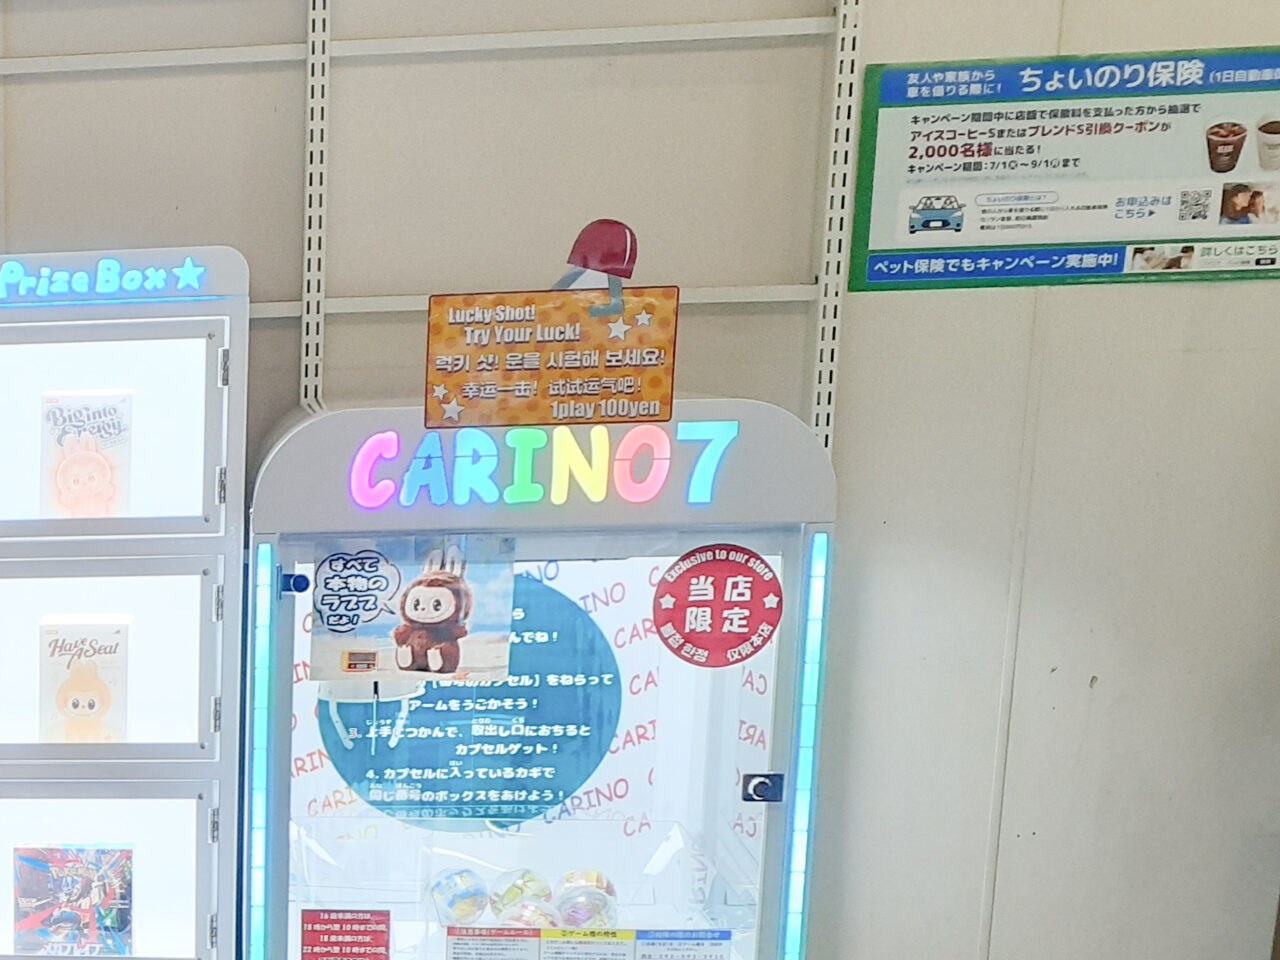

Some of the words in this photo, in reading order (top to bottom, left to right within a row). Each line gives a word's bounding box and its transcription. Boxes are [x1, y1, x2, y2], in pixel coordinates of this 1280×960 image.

[1019, 58, 1205, 93] ちょいのり保険
[95, 257, 167, 294] Box
[873, 252, 1118, 275] ペット保険でもキャンペーン実施中!
[448, 306, 492, 325] Lucky
[495, 304, 536, 322] Shot!
[464, 326, 491, 346] Try
[494, 325, 533, 343] Your
[536, 322, 581, 341] Luck!
[435, 354, 471, 372] 럭키
[505, 352, 541, 370] 운을
[546, 350, 600, 369] 시험해
[605, 348, 665, 367] 보세요!
[550, 400, 595, 420] 1play
[598, 398, 660, 418] 100yen
[350, 424, 671, 508] CARINO
[676, 420, 739, 503] 7
[329, 557, 379, 572] すべて
[664, 551, 714, 583] Exclusive
[715, 549, 727, 560] to
[728, 551, 748, 565] our
[747, 557, 774, 582] store
[324, 576, 389, 592] 本物の
[687, 575, 754, 602] 当店
[326, 613, 359, 626] だよ!
[684, 606, 750, 633] 限定
